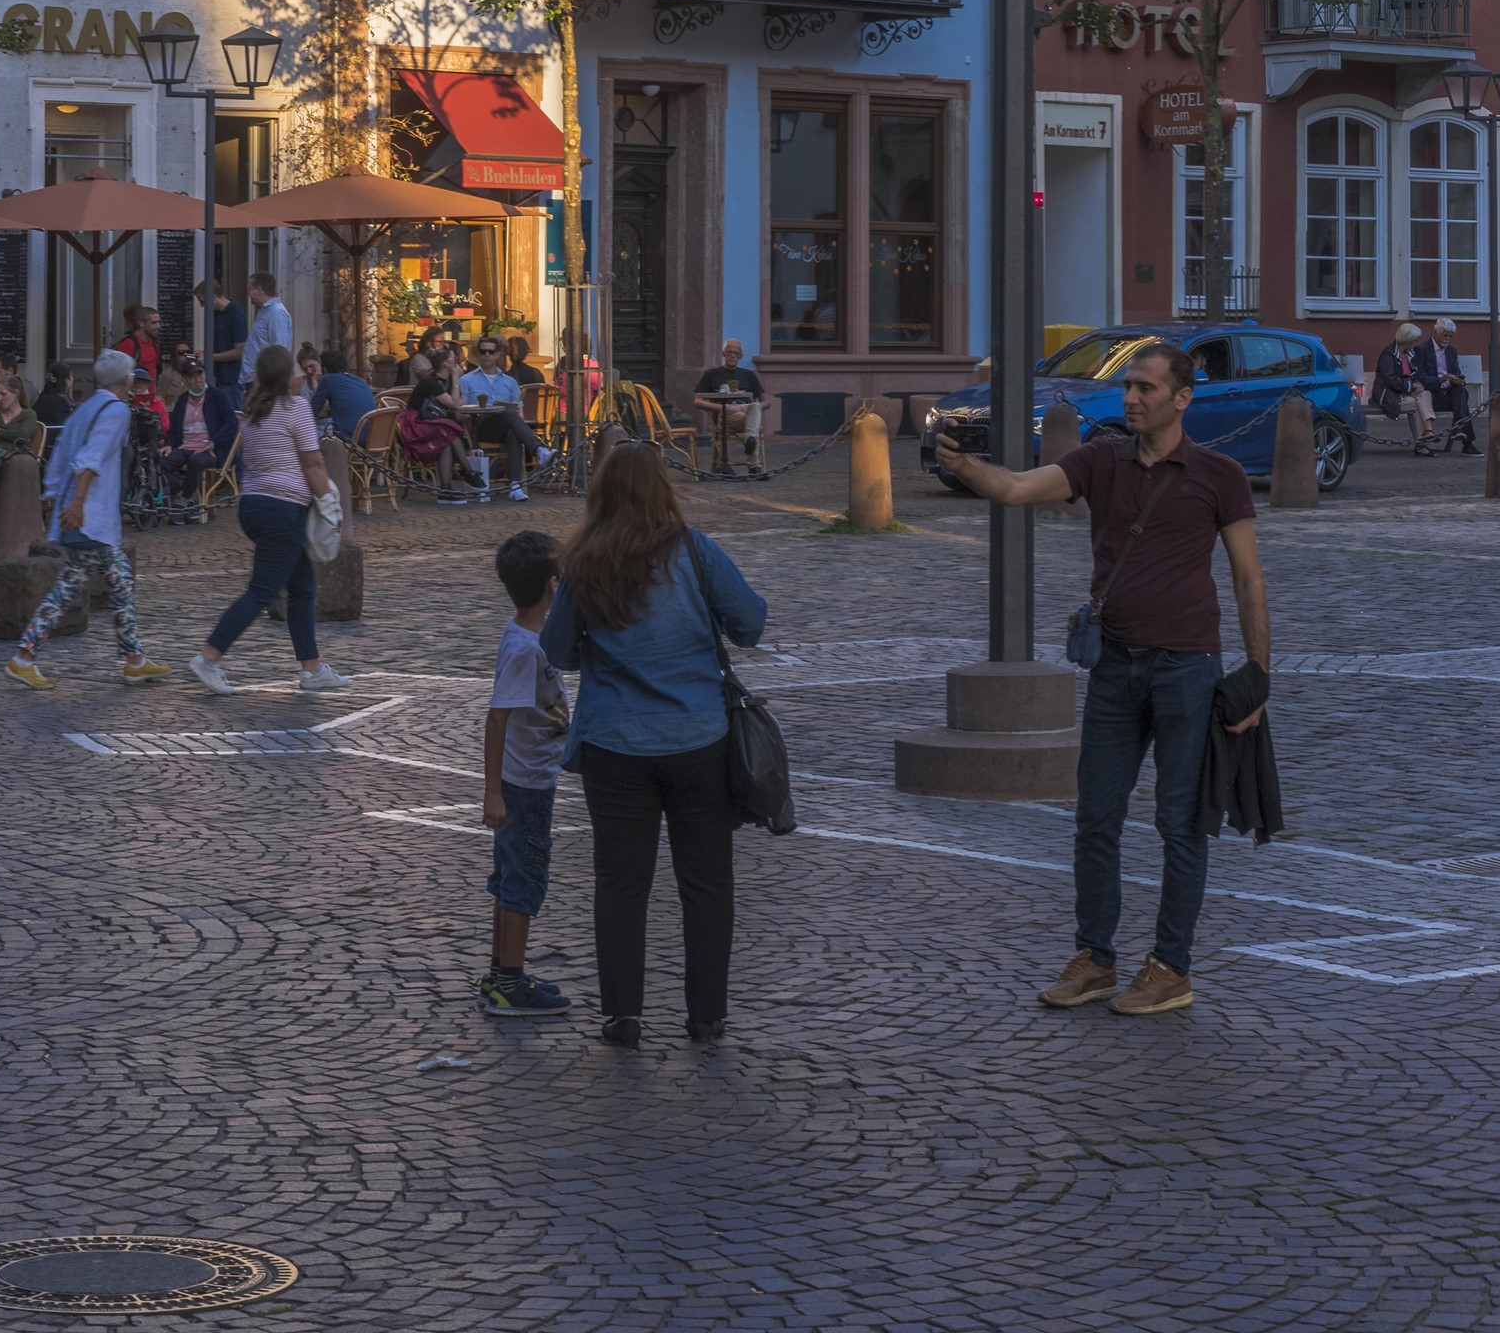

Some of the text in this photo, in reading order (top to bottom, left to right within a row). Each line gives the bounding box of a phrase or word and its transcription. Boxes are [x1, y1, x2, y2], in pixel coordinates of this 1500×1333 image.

[1160, 91, 1204, 108] HOTEL
[1173, 111, 1190, 122] am
[1044, 121, 1106, 139] Am Kornmarkt 7
[1154, 122, 1204, 137] Kornmark
[483, 166, 556, 185] Buchladen
